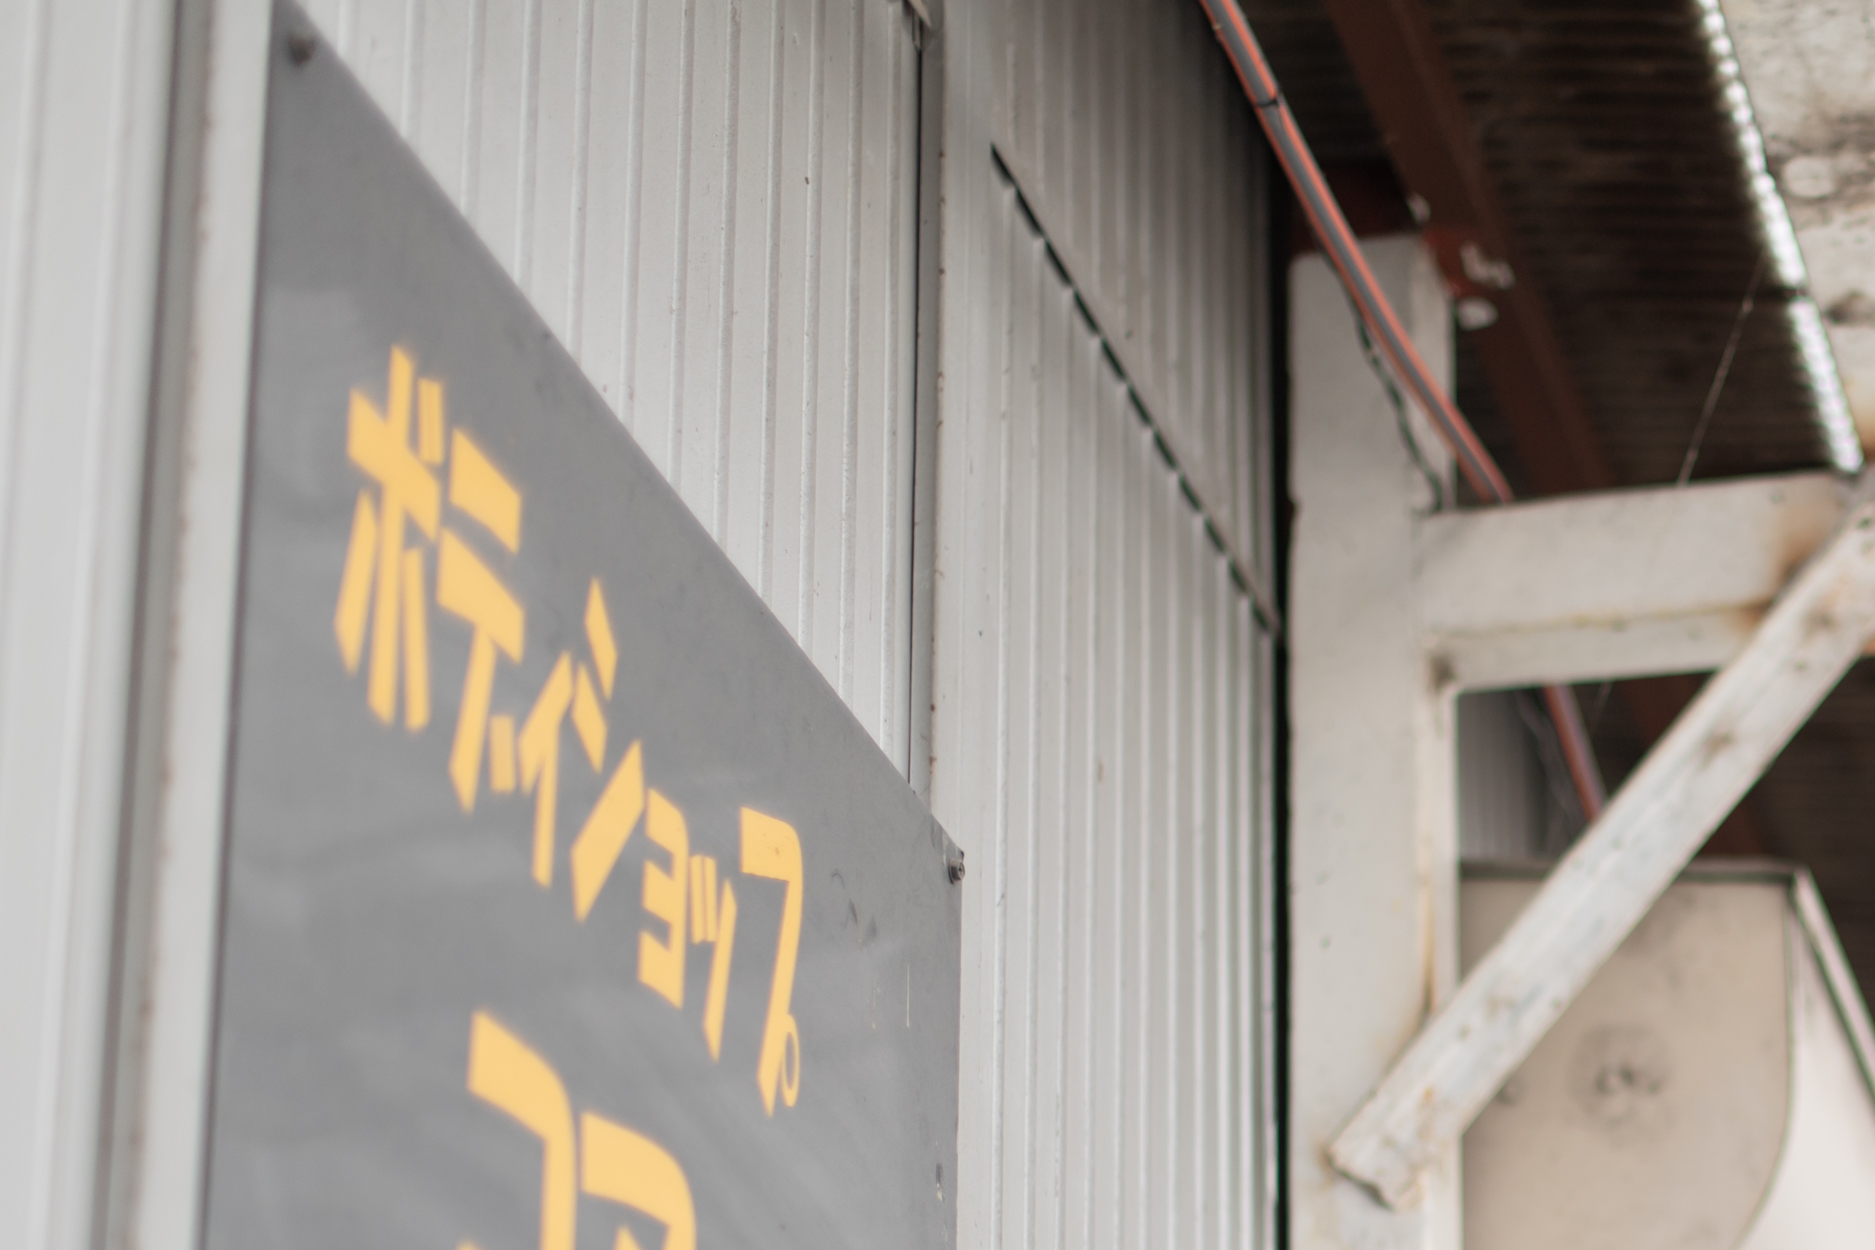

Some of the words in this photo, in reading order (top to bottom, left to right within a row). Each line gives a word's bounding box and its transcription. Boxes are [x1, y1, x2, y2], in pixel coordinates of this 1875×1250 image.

[334, 344, 803, 1118] ボディショップ
